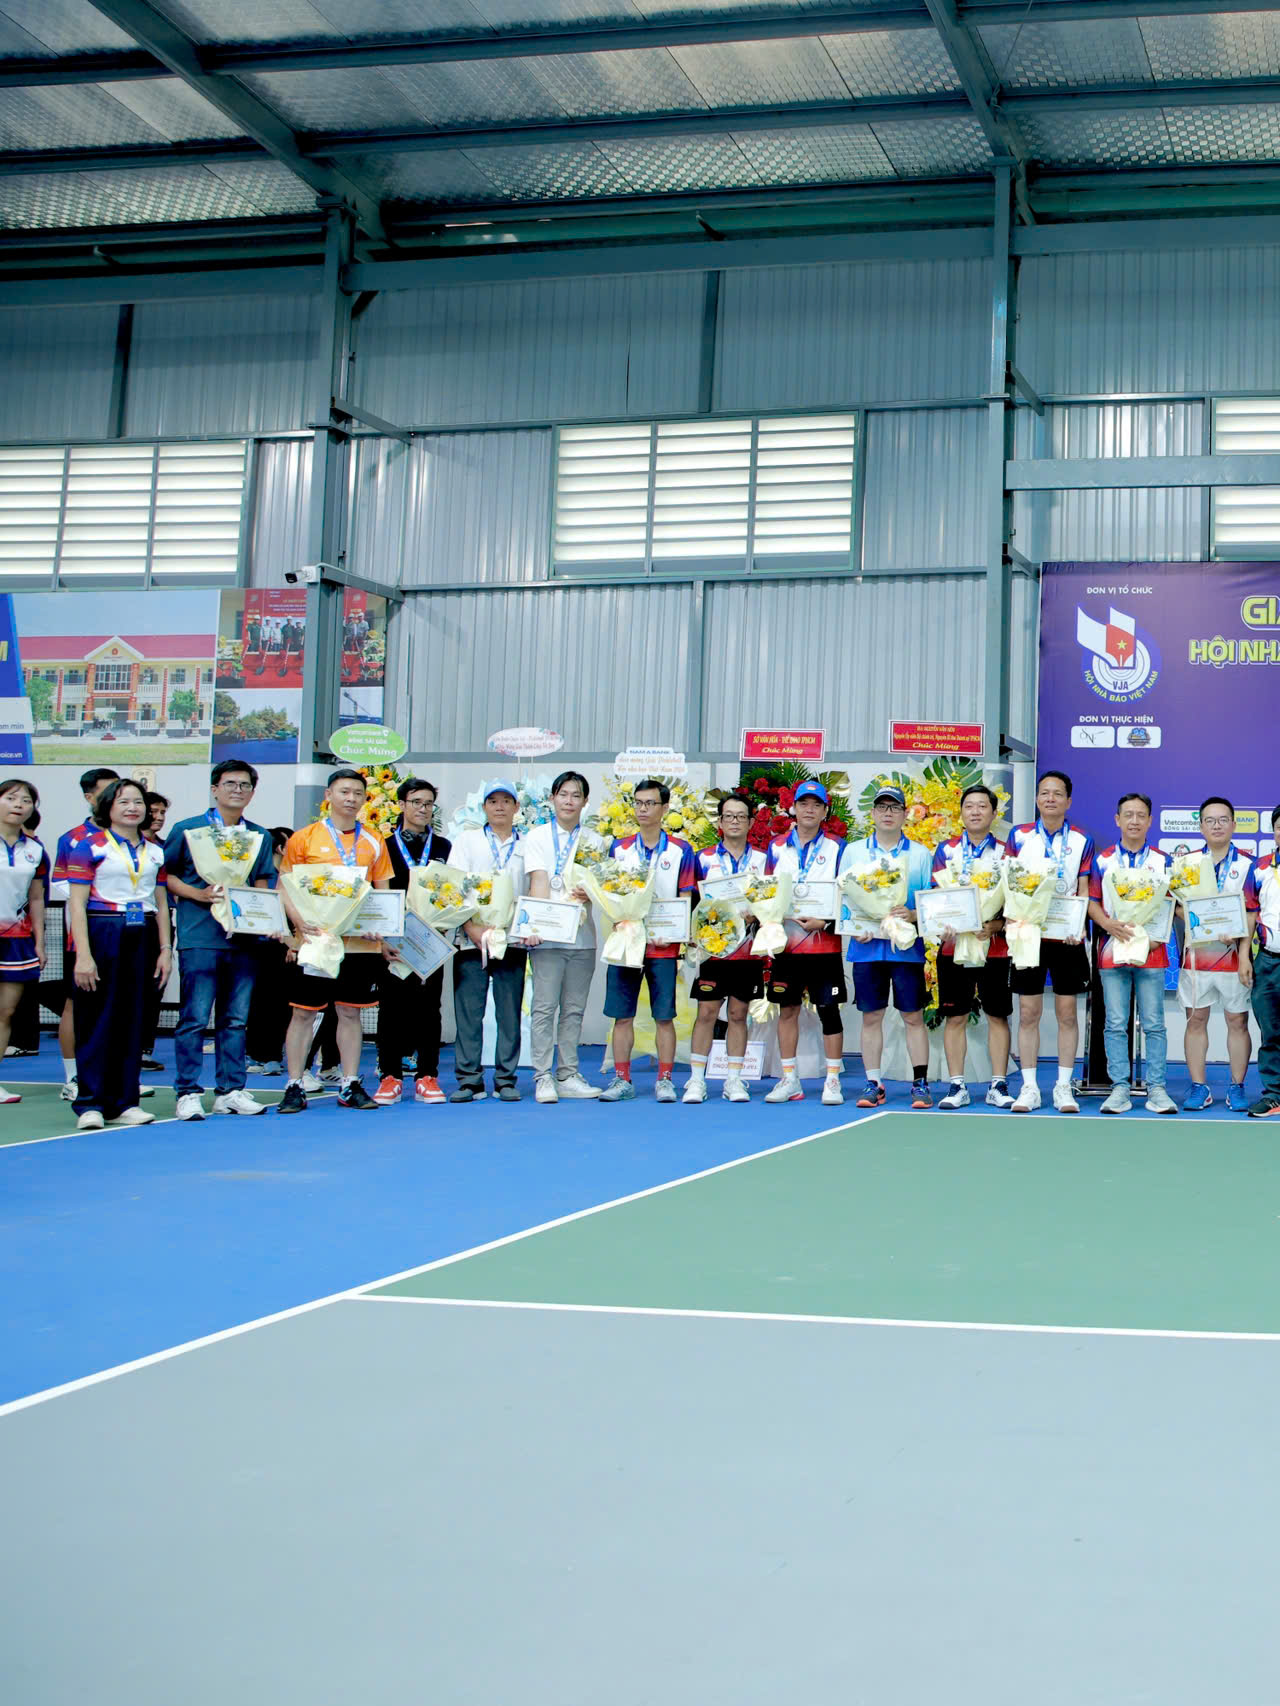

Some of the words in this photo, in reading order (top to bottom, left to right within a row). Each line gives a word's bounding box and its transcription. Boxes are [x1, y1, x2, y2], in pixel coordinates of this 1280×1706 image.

[1086, 586, 1106, 594] ĐƠN
[1108, 587, 1116, 596] VỊ
[1118, 584, 1129, 594] TỔ
[1190, 635, 1235, 667] HỘI
[1112, 681, 1129, 690] VJA
[1079, 715, 1098, 723] ĐƠN
[1100, 716, 1109, 724] VỊ
[1111, 715, 1132, 724] THỰC
[1134, 714, 1154, 724] HIỆN
